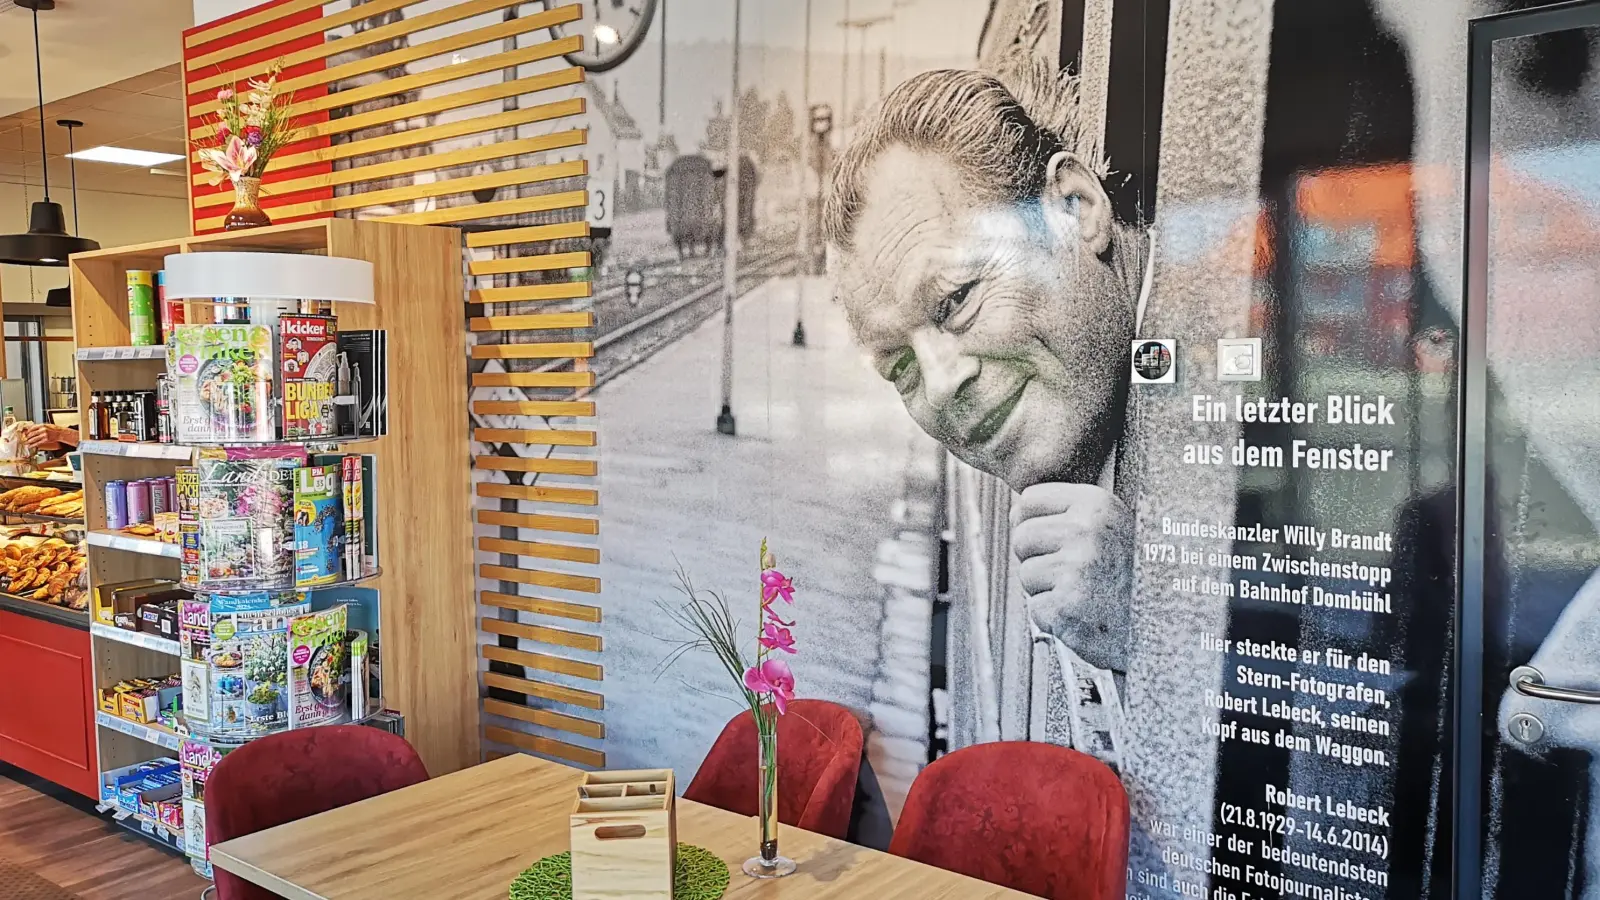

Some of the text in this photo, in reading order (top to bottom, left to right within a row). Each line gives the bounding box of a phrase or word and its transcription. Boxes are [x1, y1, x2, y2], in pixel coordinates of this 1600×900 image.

[594, 190, 605, 221] 3
[286, 320, 325, 334] kicker
[286, 401, 319, 420] LIGA
[1192, 394, 1395, 425] Ein letzter Blick
[1183, 439, 1393, 471] aus dem Fenster
[1162, 516, 1392, 552] Bundeskanzler Willy Brandt
[1144, 543, 1391, 587] 1973 bei einem Zwischenstopp
[1172, 574, 1392, 614] auf dem Bahnhof Dombühl
[1200, 632, 1391, 675] Hier steckte er für den
[1236, 665, 1391, 709] Stern-Fotografen,
[1204, 688, 1390, 736] Robert Lebeck, seinen
[1201, 717, 1390, 768] Kopf aus dem Waggon.
[1265, 783, 1391, 828] Robert Lebeck
[1220, 801, 1390, 861] (21.8.1929-14.6.2014)
[1150, 819, 1388, 887] war einer der bedeutendsten
[1162, 846, 1240, 880] deutschen
[1138, 868, 1167, 890] sind
[1172, 878, 1209, 900] auch
